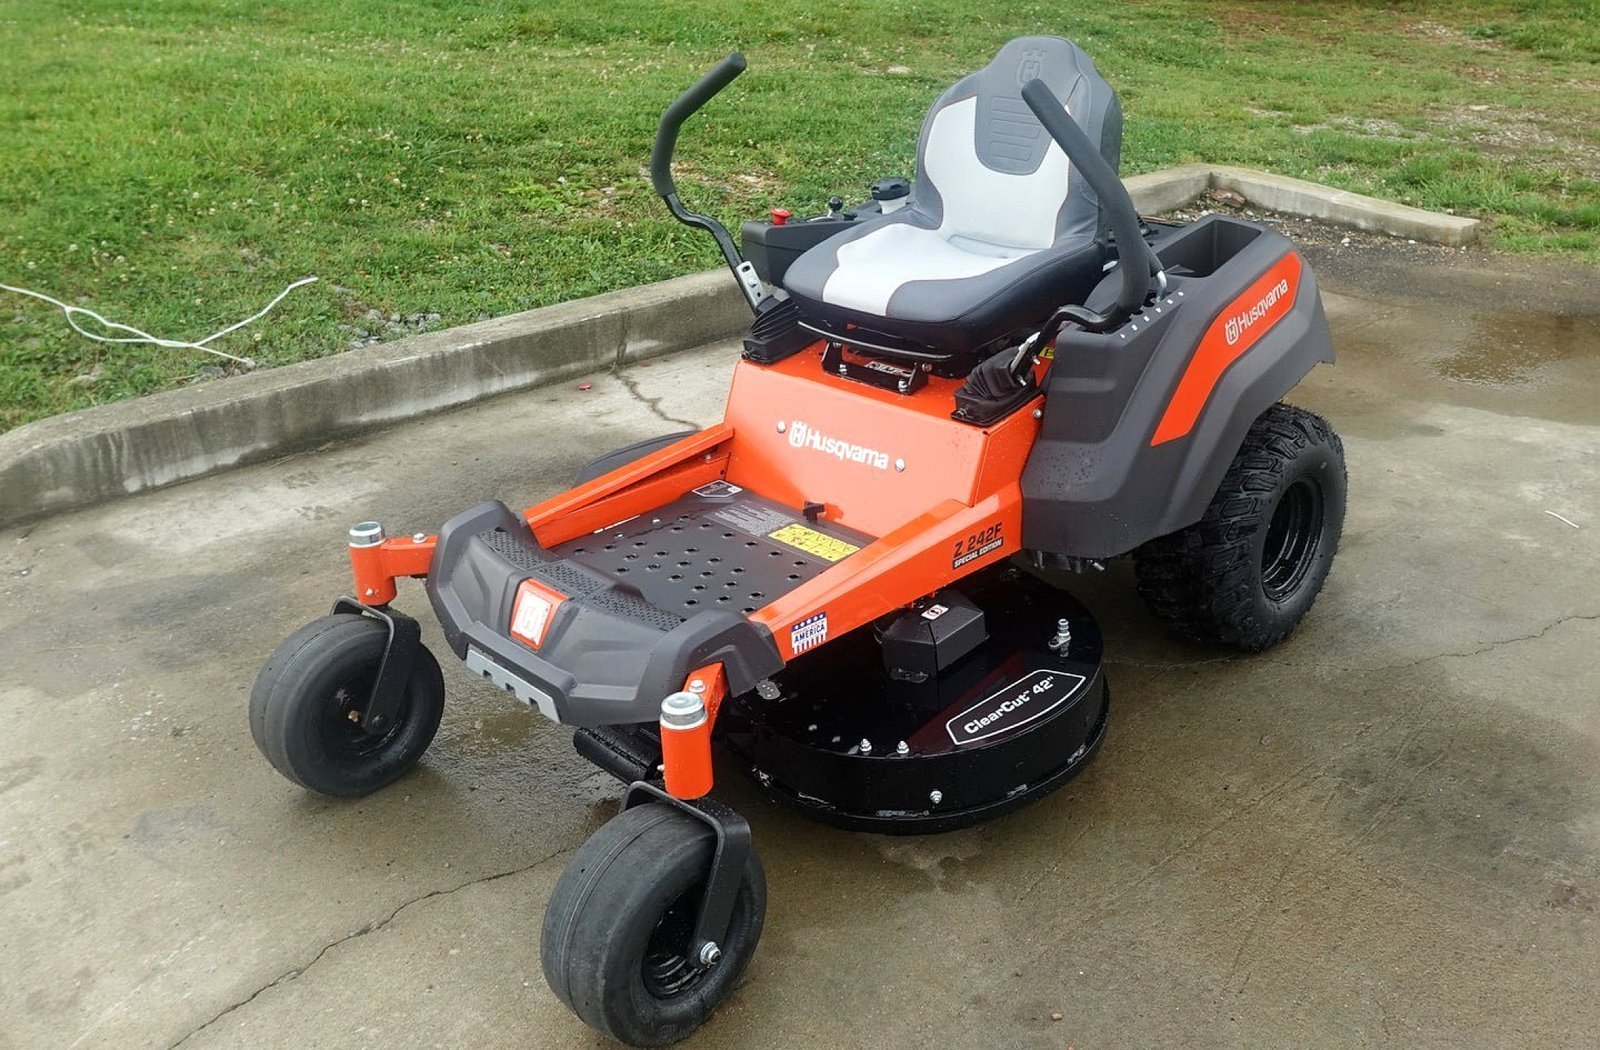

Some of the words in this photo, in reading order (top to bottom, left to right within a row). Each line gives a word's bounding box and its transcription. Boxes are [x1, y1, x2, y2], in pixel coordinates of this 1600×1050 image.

[1238, 279, 1288, 333] Husqvarna
[805, 427, 889, 470] Husqvarna
[953, 541, 964, 558] Z
[967, 521, 1003, 551] 242F
[794, 623, 825, 643] AMERICA
[1032, 675, 1055, 695] 42"
